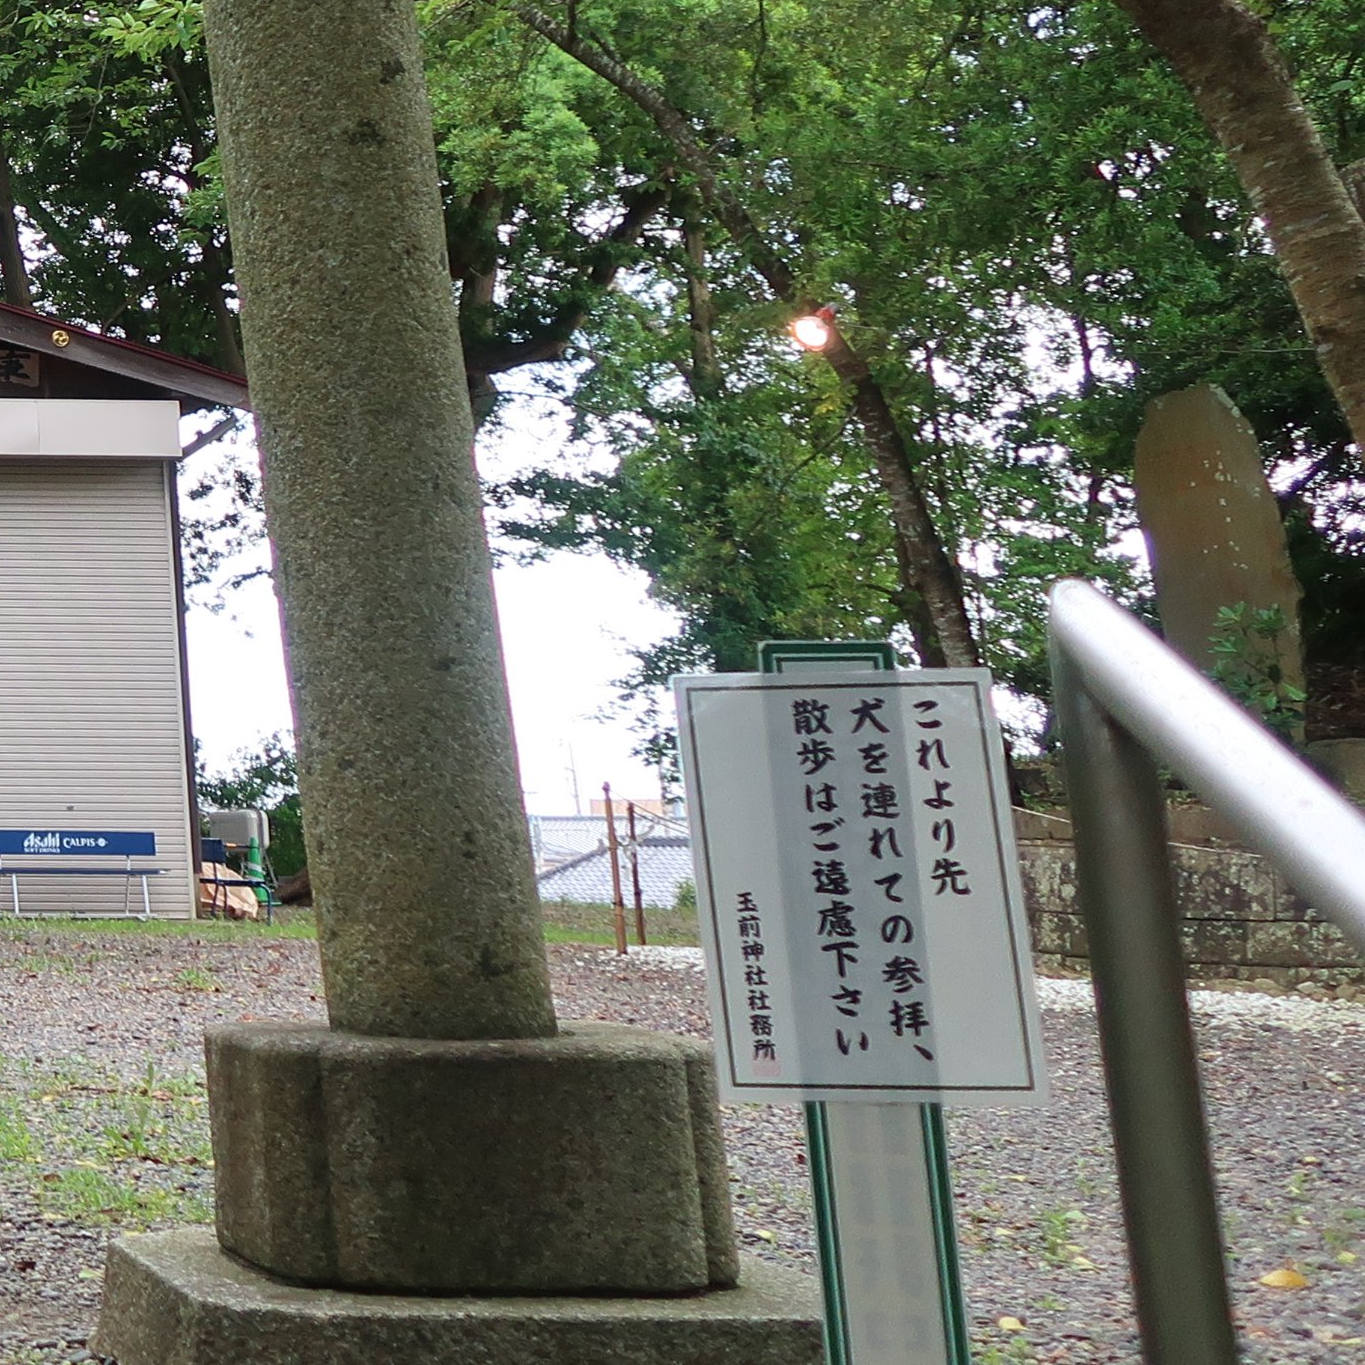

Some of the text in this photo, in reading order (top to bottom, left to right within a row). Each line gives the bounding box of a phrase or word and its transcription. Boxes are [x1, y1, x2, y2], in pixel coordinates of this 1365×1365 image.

[23, 832, 96, 849] Asahi CALPIS
[792, 698, 870, 1056] 散歩はご遠慮下さい
[850, 698, 935, 1062] 犬を連れての参拝、
[912, 699, 971, 896] これより先
[736, 891, 777, 1061] 玉前神社社務所
